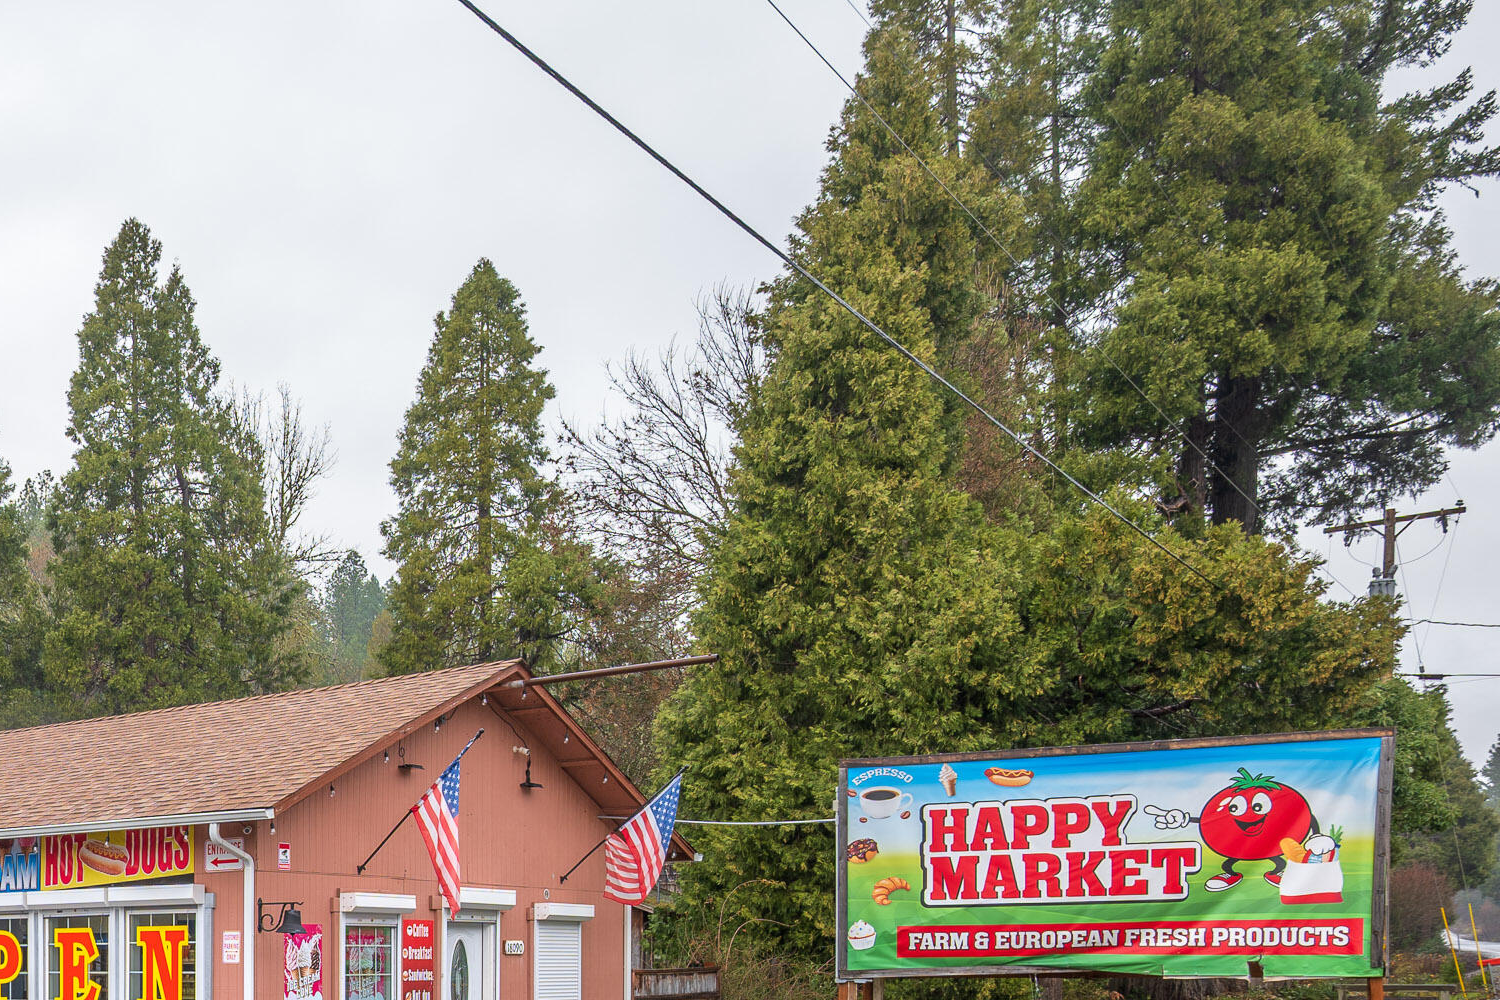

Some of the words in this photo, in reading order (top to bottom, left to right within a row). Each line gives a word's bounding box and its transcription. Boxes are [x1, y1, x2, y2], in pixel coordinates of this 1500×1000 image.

[851, 768, 914, 786] ESPRESSO
[928, 799, 1133, 853] HAPPY
[44, 832, 89, 887] HOT
[124, 824, 191, 877] DOGS
[929, 847, 1197, 901] MARKET
[907, 931, 971, 952] FARM
[974, 931, 990, 951] &
[994, 929, 1119, 951] EUROPEAN
[1124, 927, 1206, 949] FRESH
[1211, 926, 1350, 948] PRODUCTS
